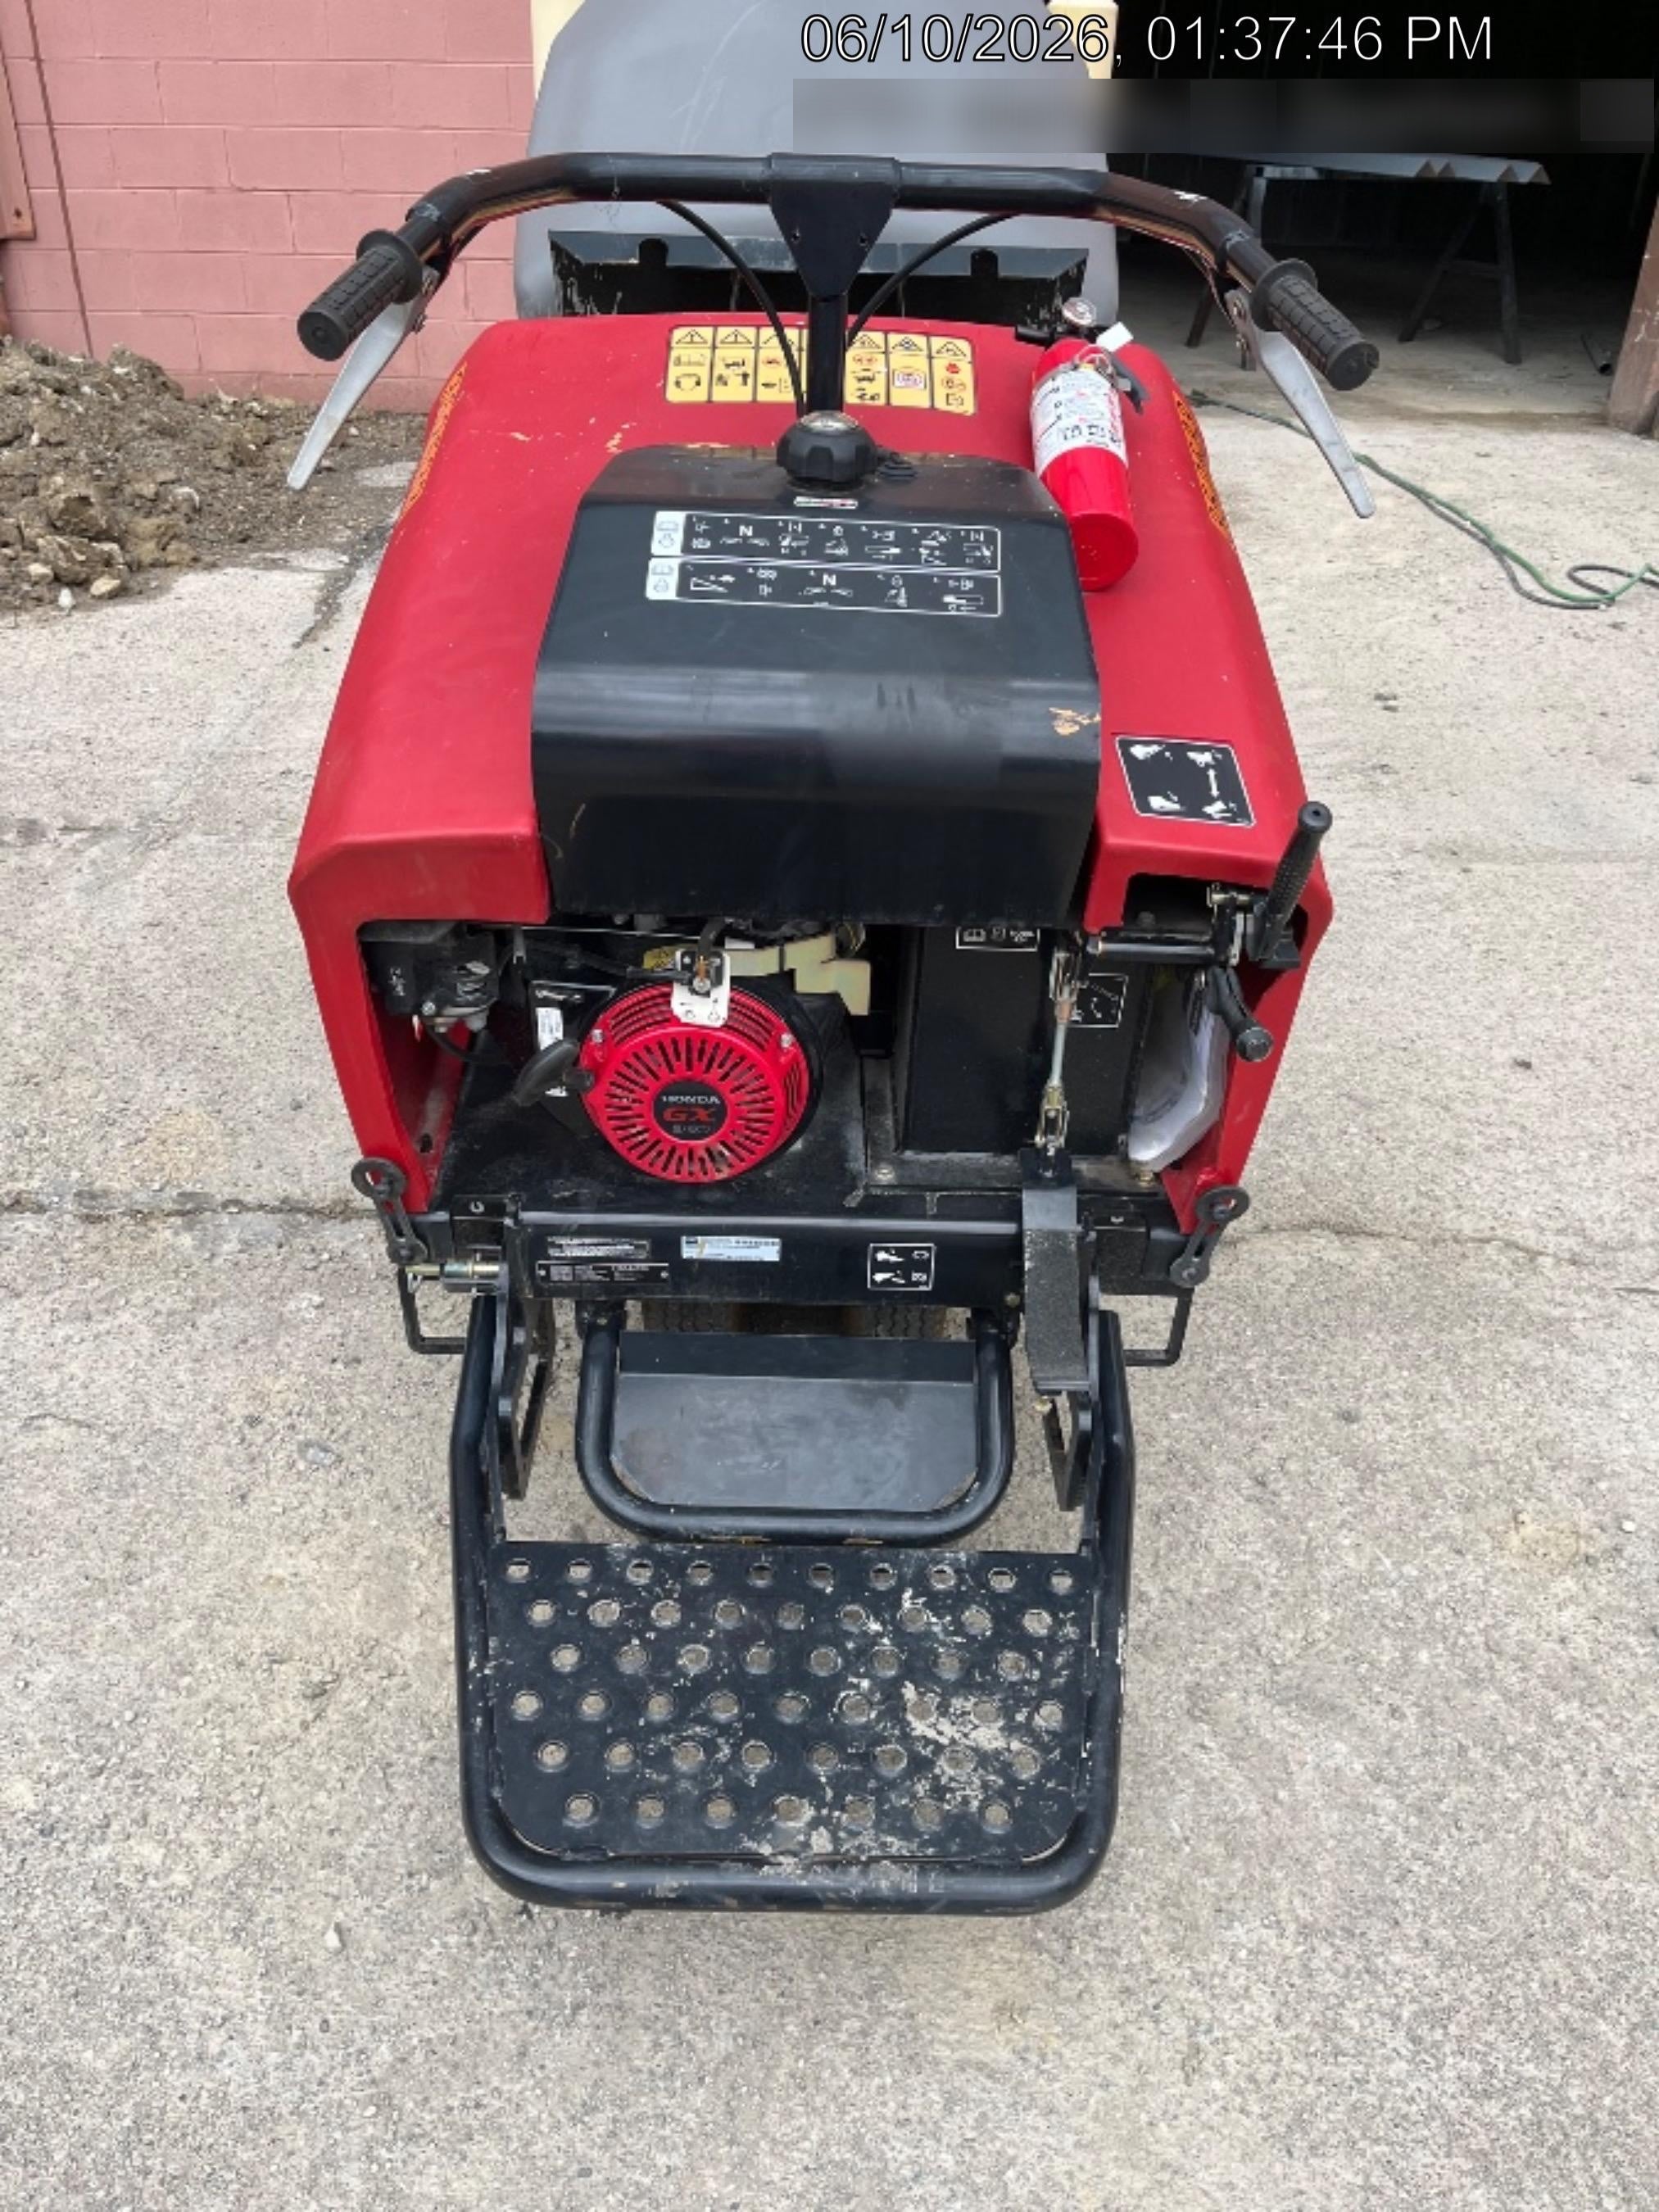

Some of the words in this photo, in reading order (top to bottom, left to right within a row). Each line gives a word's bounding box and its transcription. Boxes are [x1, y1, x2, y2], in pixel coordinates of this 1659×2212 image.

[738, 524, 754, 537] N
[822, 573, 837, 587] N
[662, 1095, 721, 1105] HONDA
[662, 1106, 716, 1123] GX
